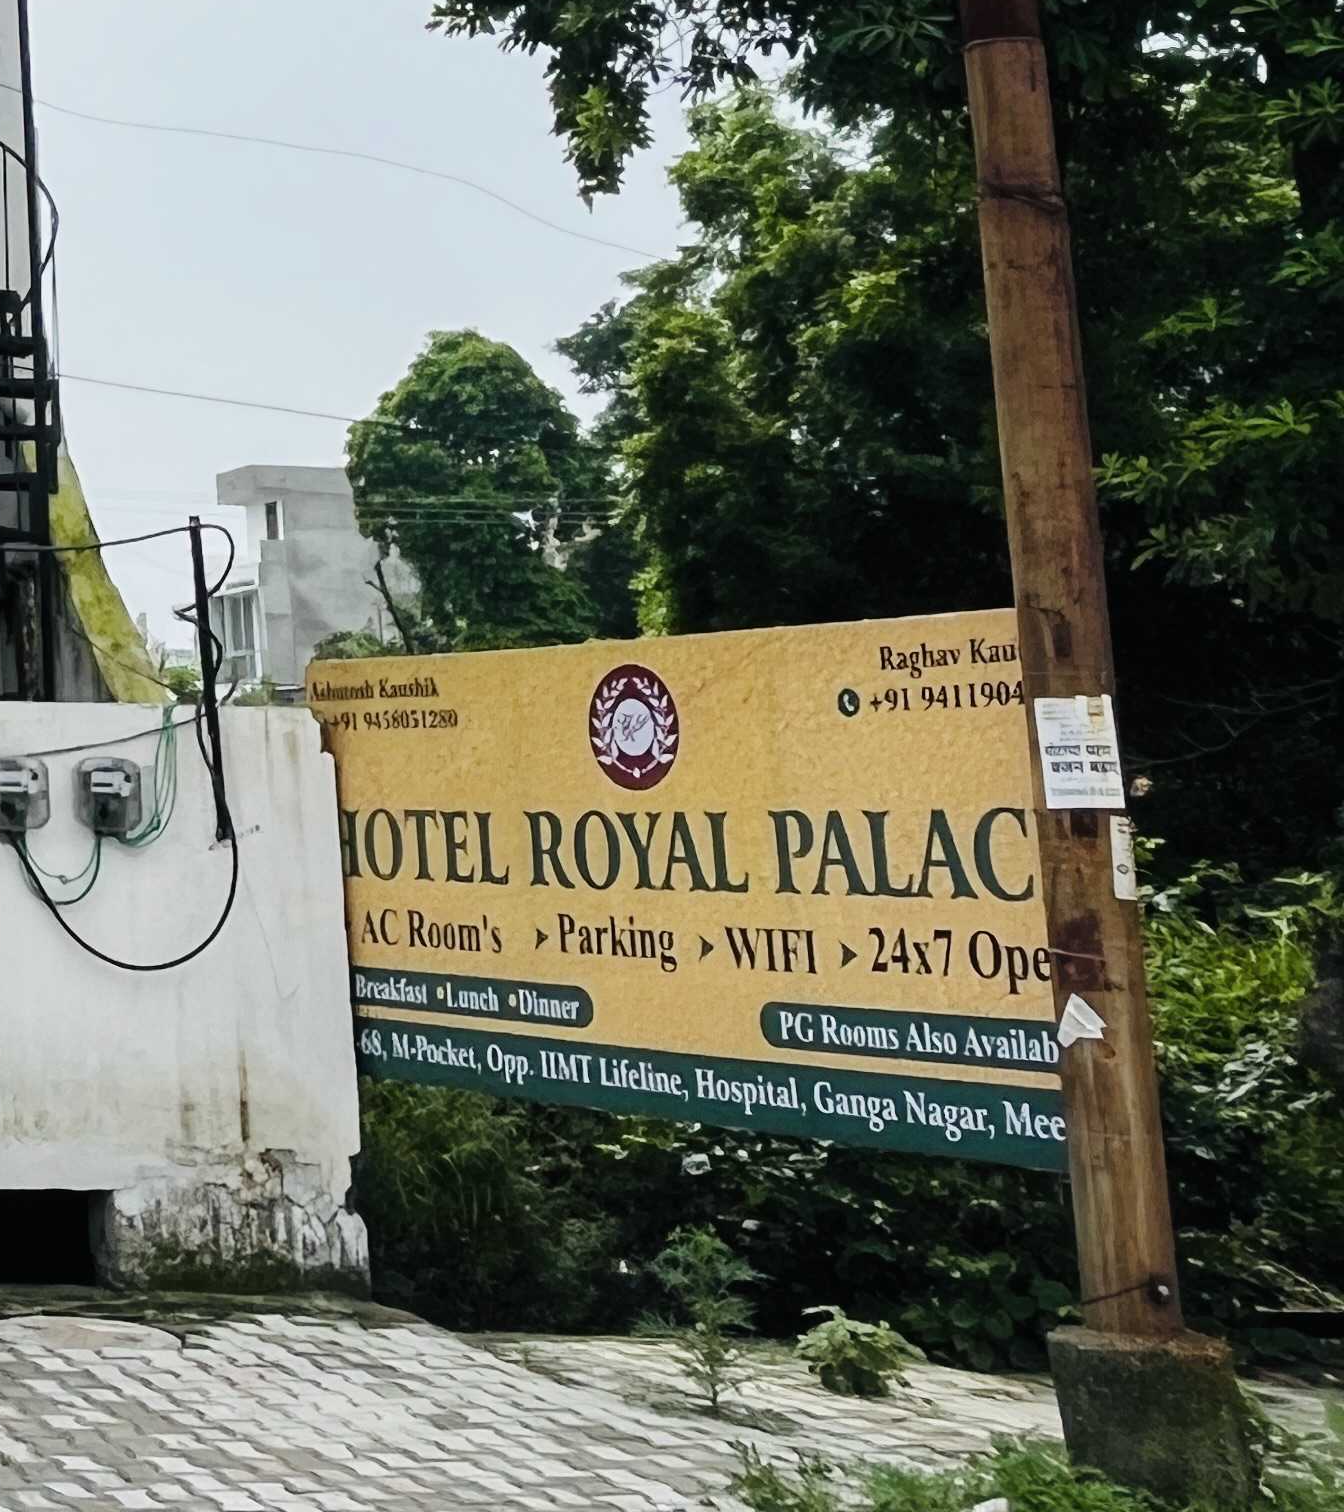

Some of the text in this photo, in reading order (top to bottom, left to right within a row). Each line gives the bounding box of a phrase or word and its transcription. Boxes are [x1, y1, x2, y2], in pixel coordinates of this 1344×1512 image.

[879, 642, 961, 679] Raghav
[379, 676, 440, 699] Kaushik
[869, 688, 911, 713] +91
[921, 680, 1025, 712] 9411904
[523, 809, 750, 893] ROYAL
[767, 807, 1035, 902] PALAC
[361, 908, 1052, 995] AC Room's Parking WIFI 24x7 Ope
[355, 973, 580, 1021] Breakfast Lunch Dinner
[779, 1010, 1060, 1064] PG Rooms Also Availab
[356, 1028, 1067, 1142] -68, M-Pocket, Opp. IIMT Lifeline, Hospital, Ganga Nagar, Mee
